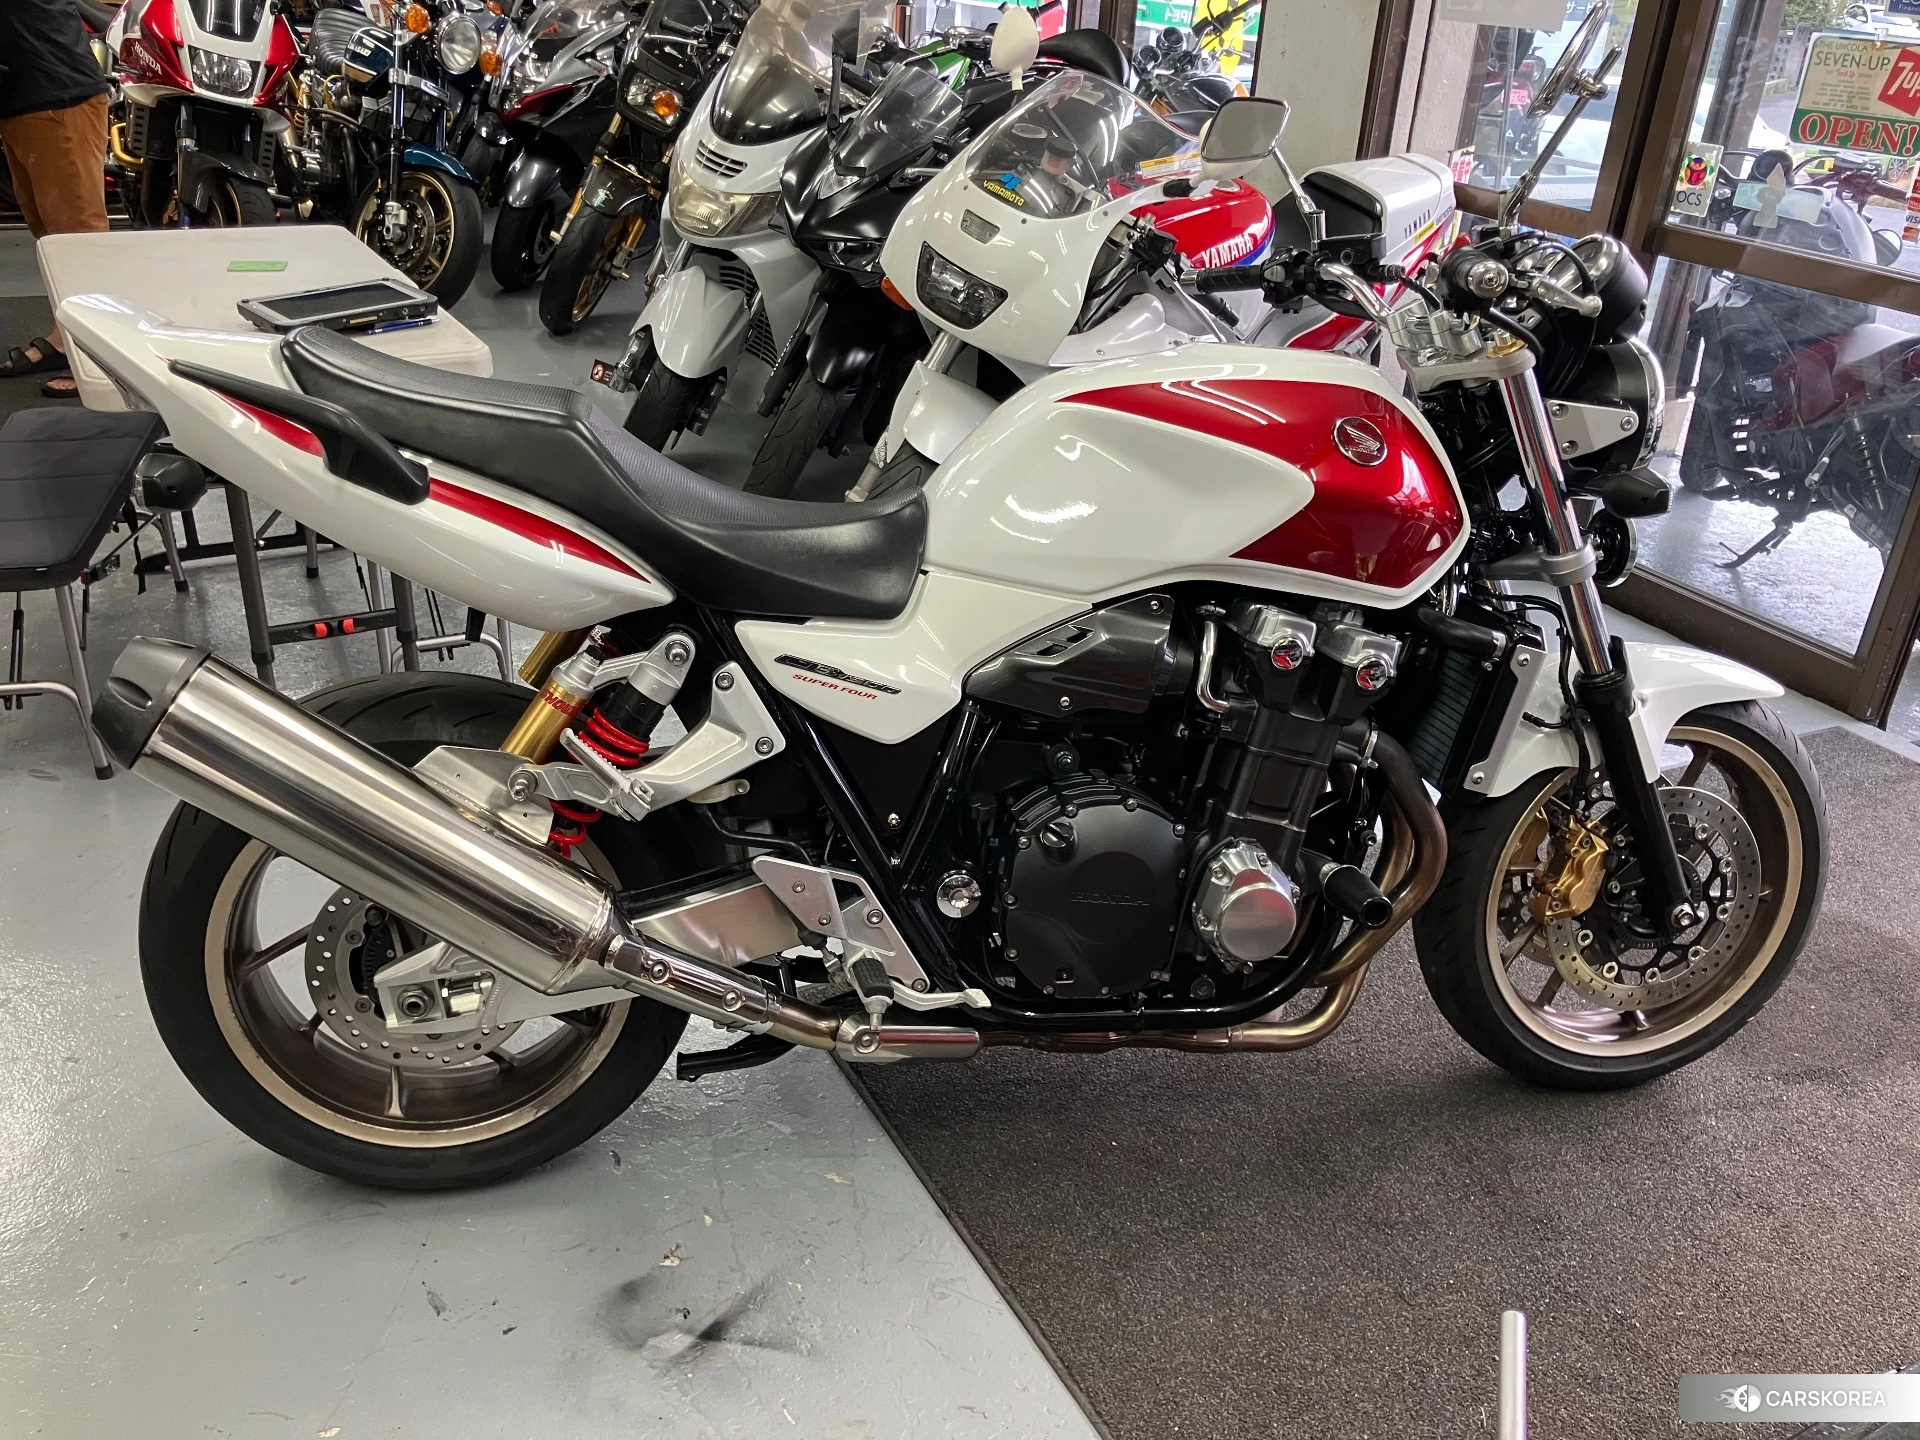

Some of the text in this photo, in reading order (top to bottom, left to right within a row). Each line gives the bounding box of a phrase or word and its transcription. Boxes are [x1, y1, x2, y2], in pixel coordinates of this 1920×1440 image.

[135, 41, 162, 75] HONDA
[1835, 41, 1868, 52] UNCOLA
[1814, 51, 1891, 72] SEVEN-UP
[1798, 113, 1919, 156] OPEN!
[983, 180, 1025, 206] YAMAMOTO
[1676, 190, 1703, 206] OCS
[1403, 208, 1431, 239] YAMAHA
[1906, 215, 1920, 223] VIS
[1201, 233, 1253, 268] YAMAHA
[792, 674, 878, 700] SUPER FOUR
